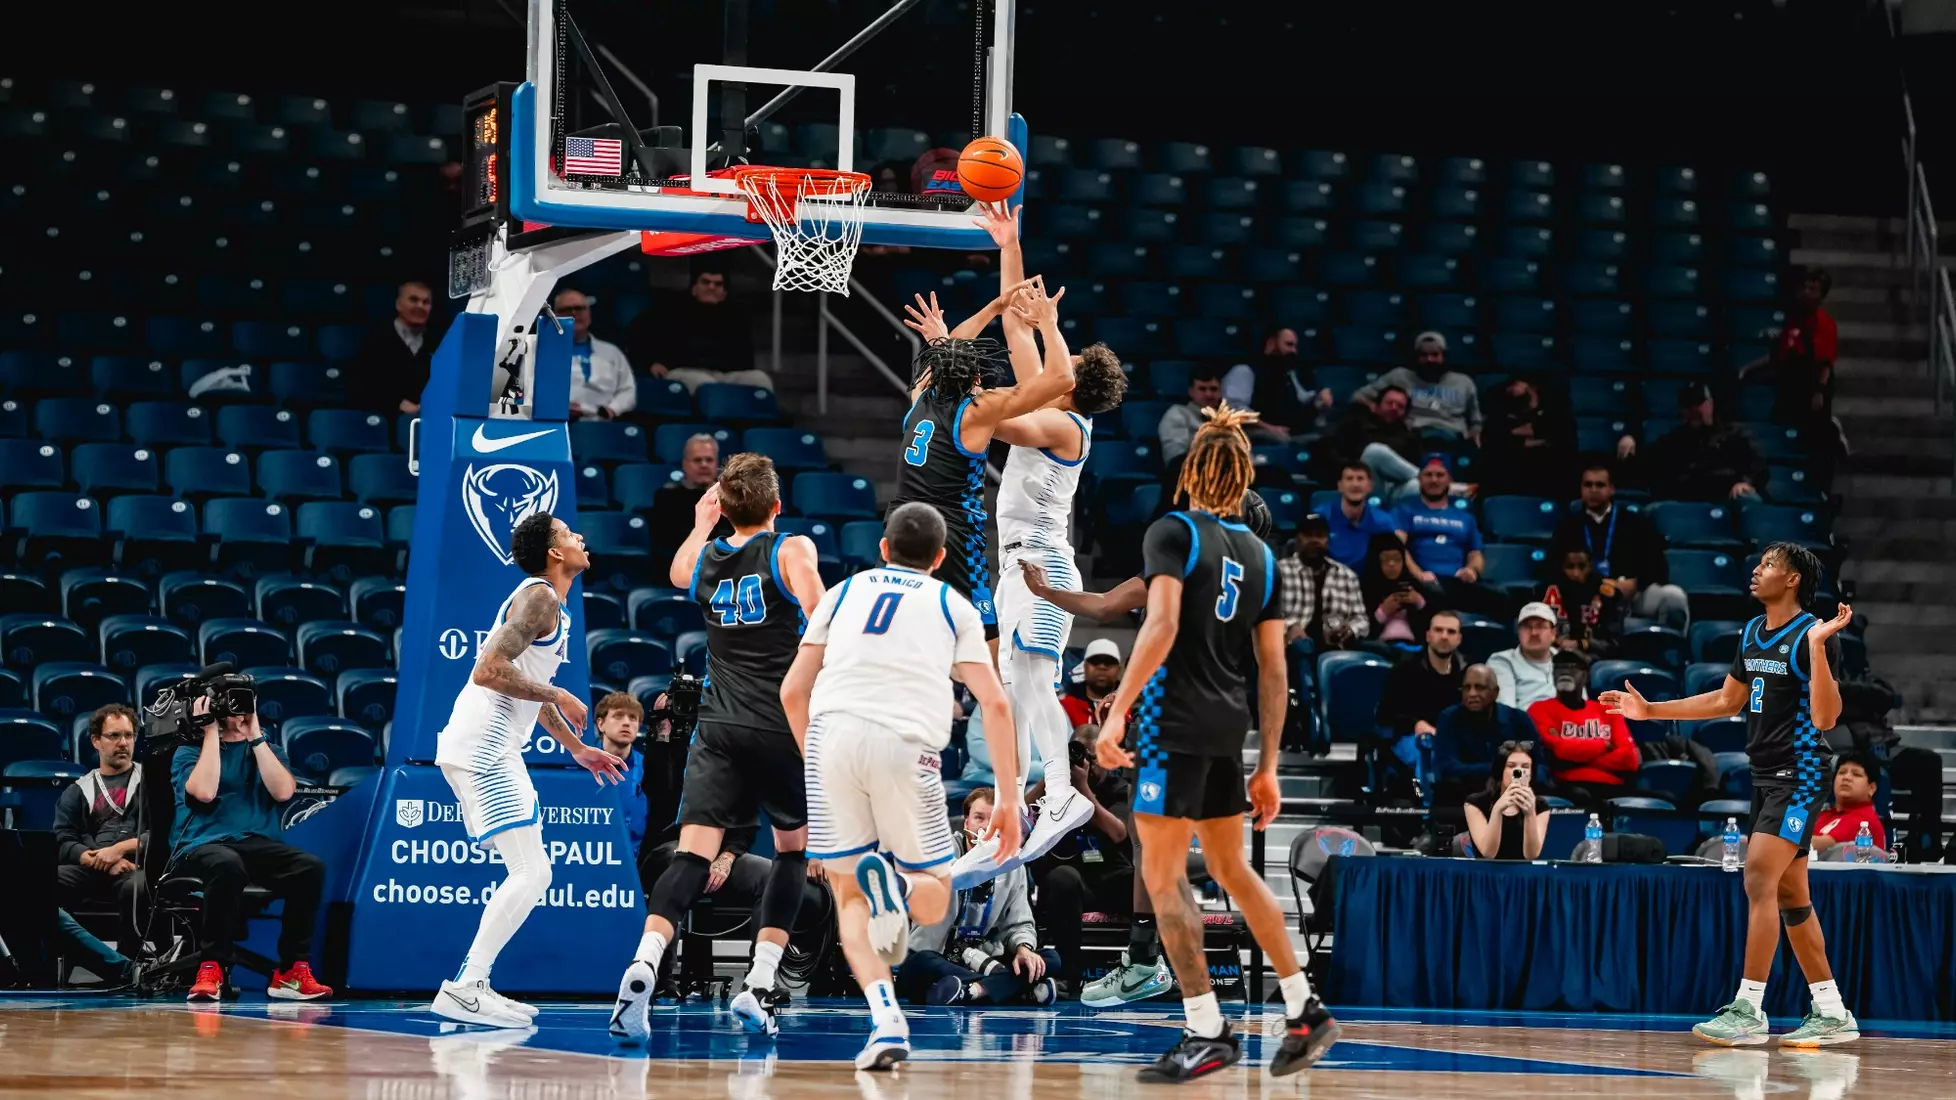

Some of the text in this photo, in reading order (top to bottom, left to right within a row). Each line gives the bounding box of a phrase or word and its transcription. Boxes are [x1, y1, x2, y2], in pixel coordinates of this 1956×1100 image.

[904, 419, 935, 467] 3
[710, 573, 767, 626] 40
[1215, 556, 1244, 623] 5
[862, 592, 905, 635] 0
[1750, 677, 1764, 713] 2
[1561, 718, 1611, 741] Bulls
[391, 840, 504, 864] CHOOSE
